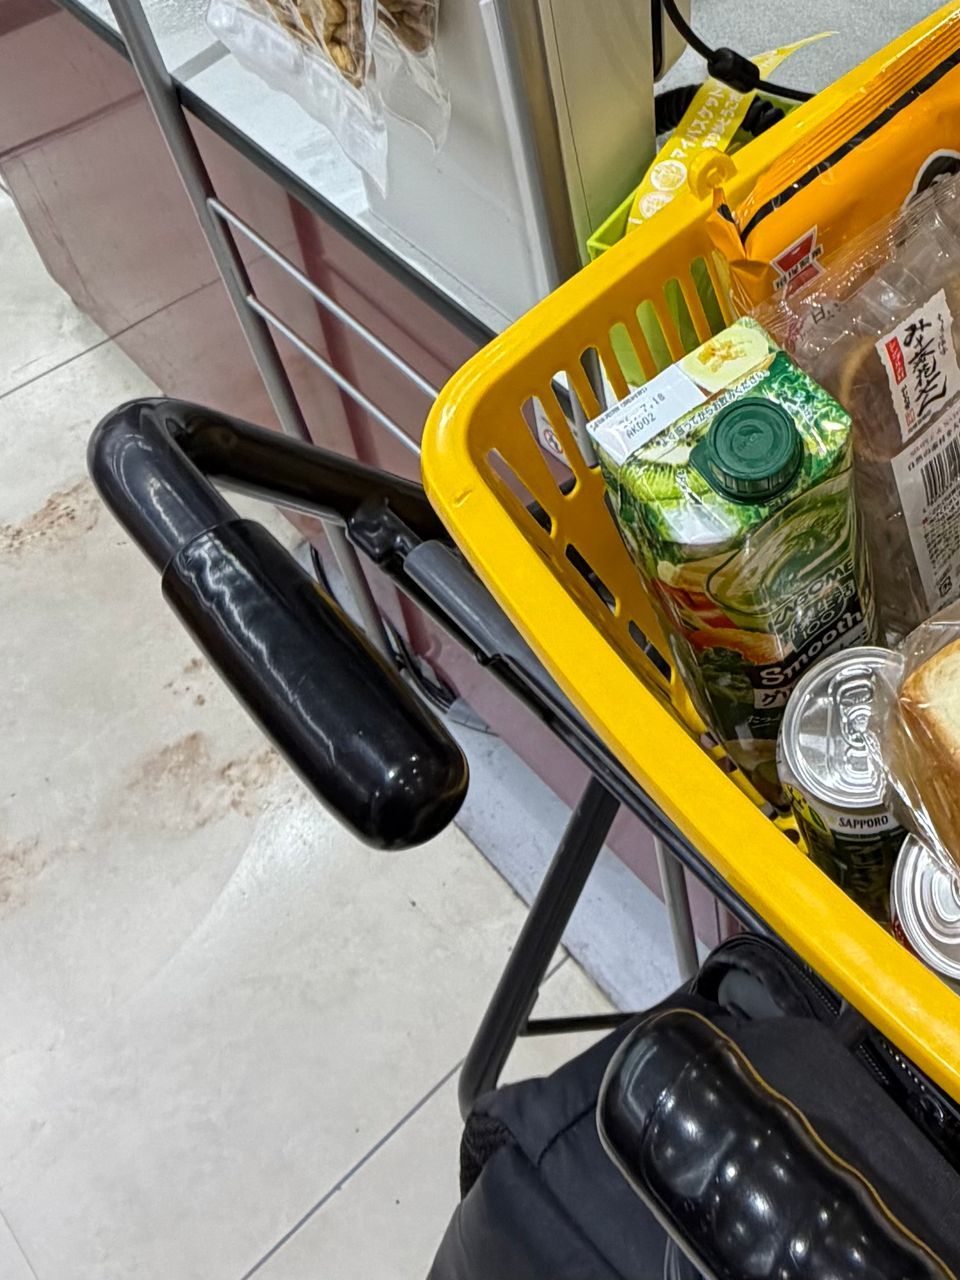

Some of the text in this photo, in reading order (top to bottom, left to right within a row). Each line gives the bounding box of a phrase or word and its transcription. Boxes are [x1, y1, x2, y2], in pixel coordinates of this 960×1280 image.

[670, 84, 726, 159] マイバスケット
[760, 611, 862, 686] Smooth
[838, 814, 889, 829] SAPPORO
